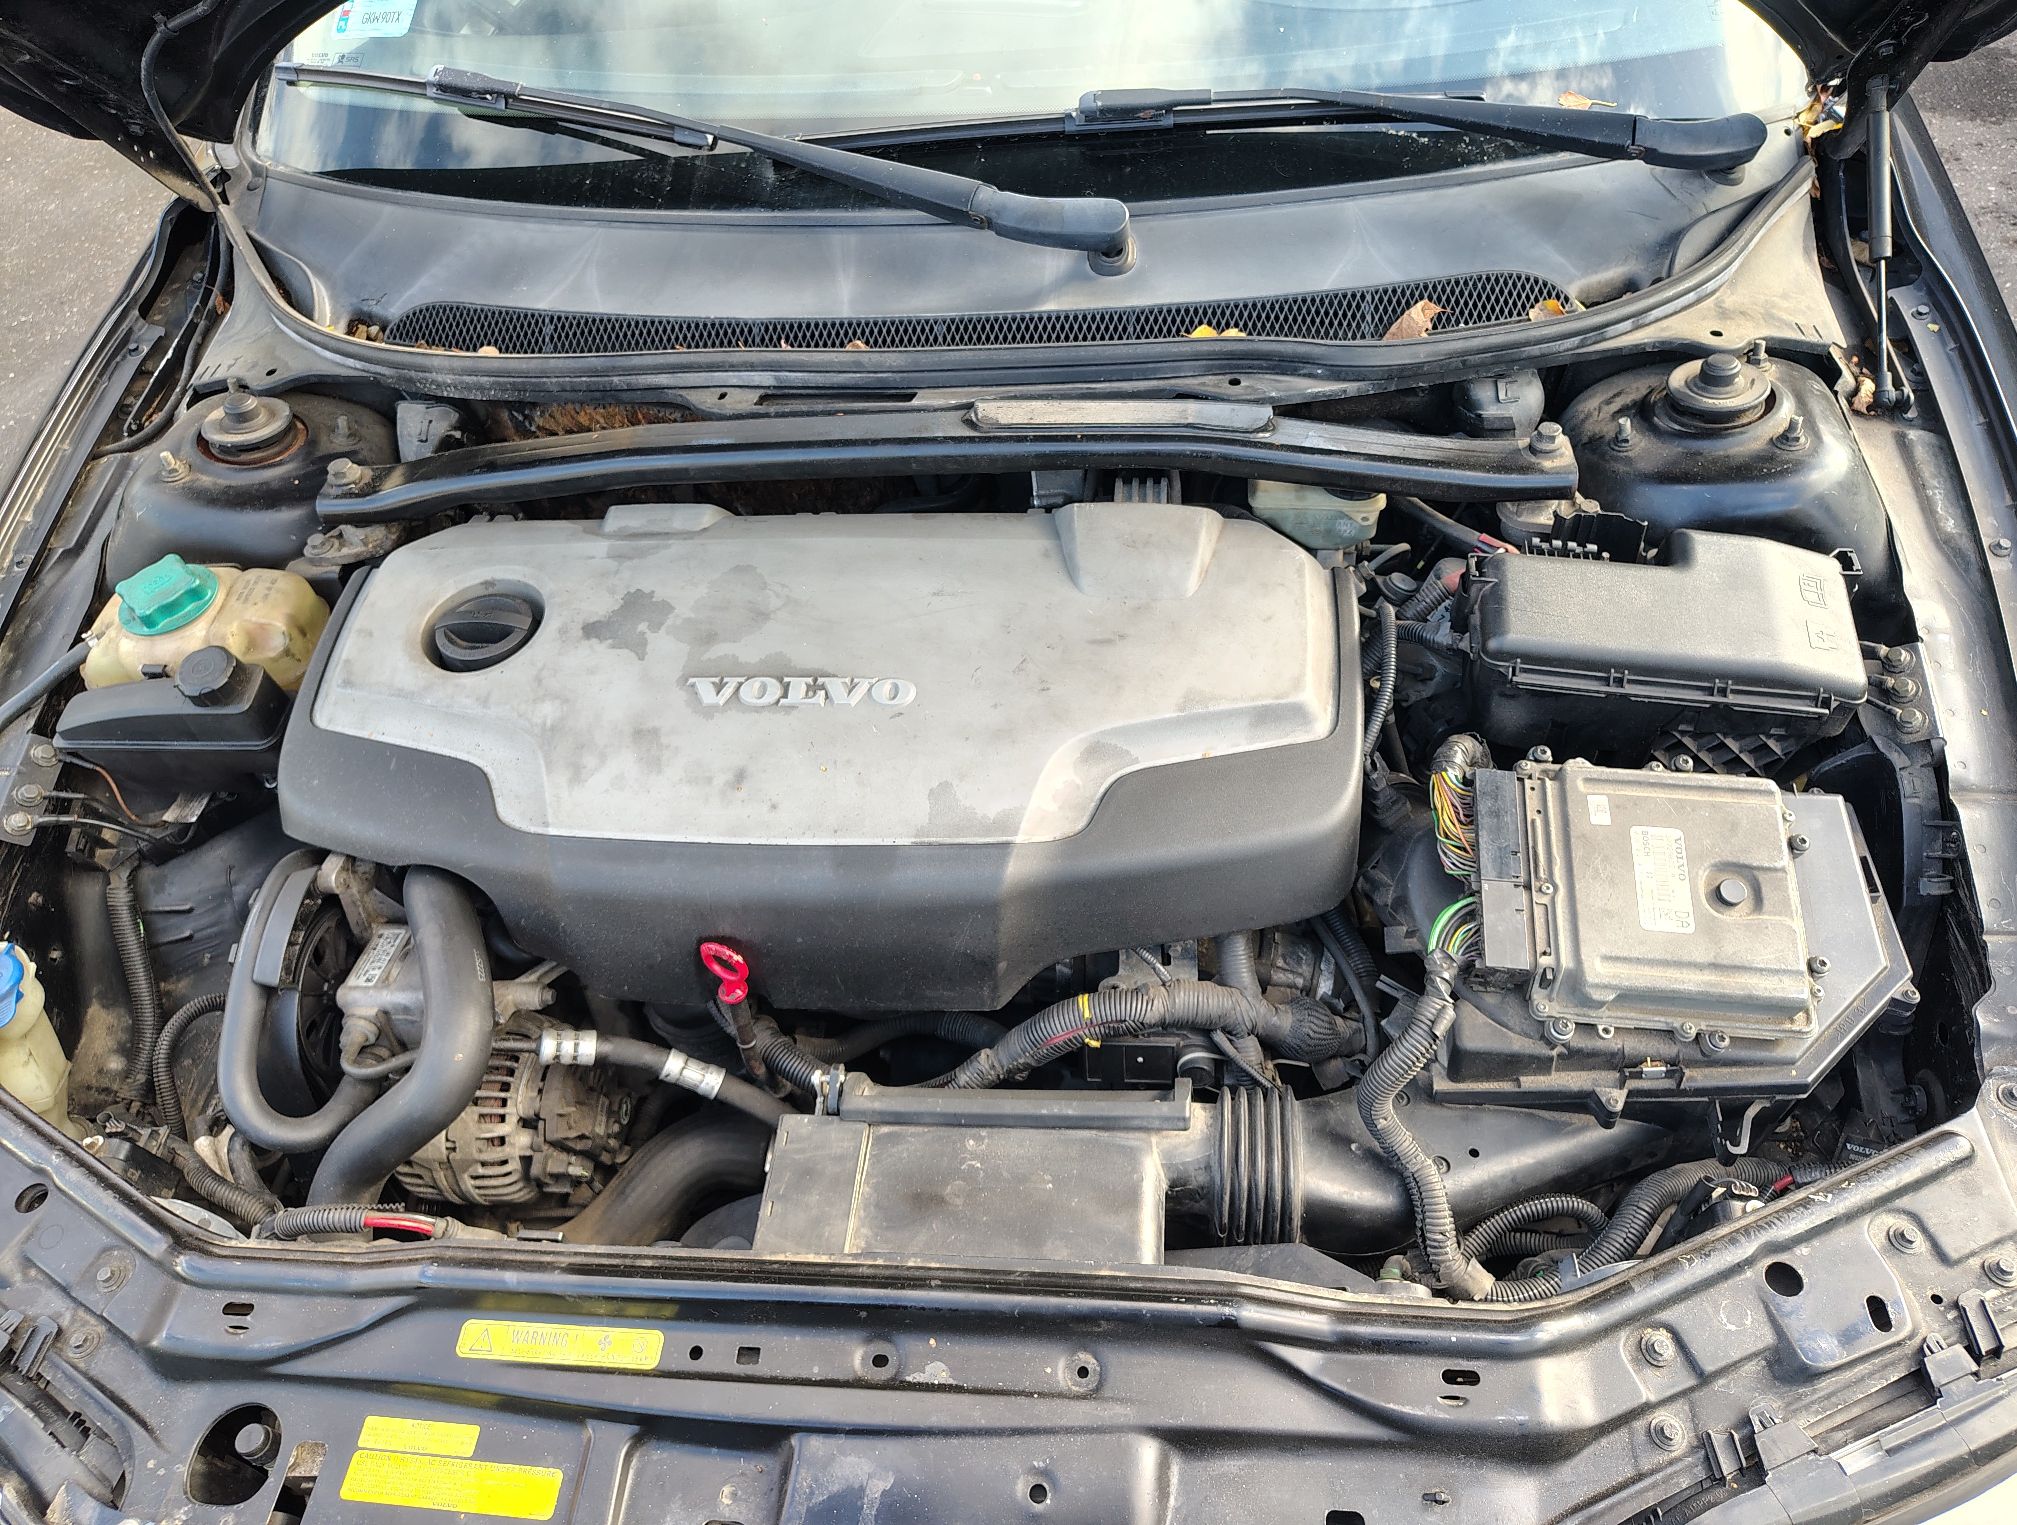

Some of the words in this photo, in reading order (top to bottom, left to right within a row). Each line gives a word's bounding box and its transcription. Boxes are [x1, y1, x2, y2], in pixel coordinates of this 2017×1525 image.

[687, 676, 917, 707] VOLVO
[1641, 830, 1651, 857] BOSCH
[1674, 835, 1687, 882] VOLVO
[1674, 910, 1691, 929] DA
[511, 1328, 570, 1348] WARNING
[359, 1452, 391, 1462] CAUTION
[518, 1467, 558, 1478] PRESSURE
